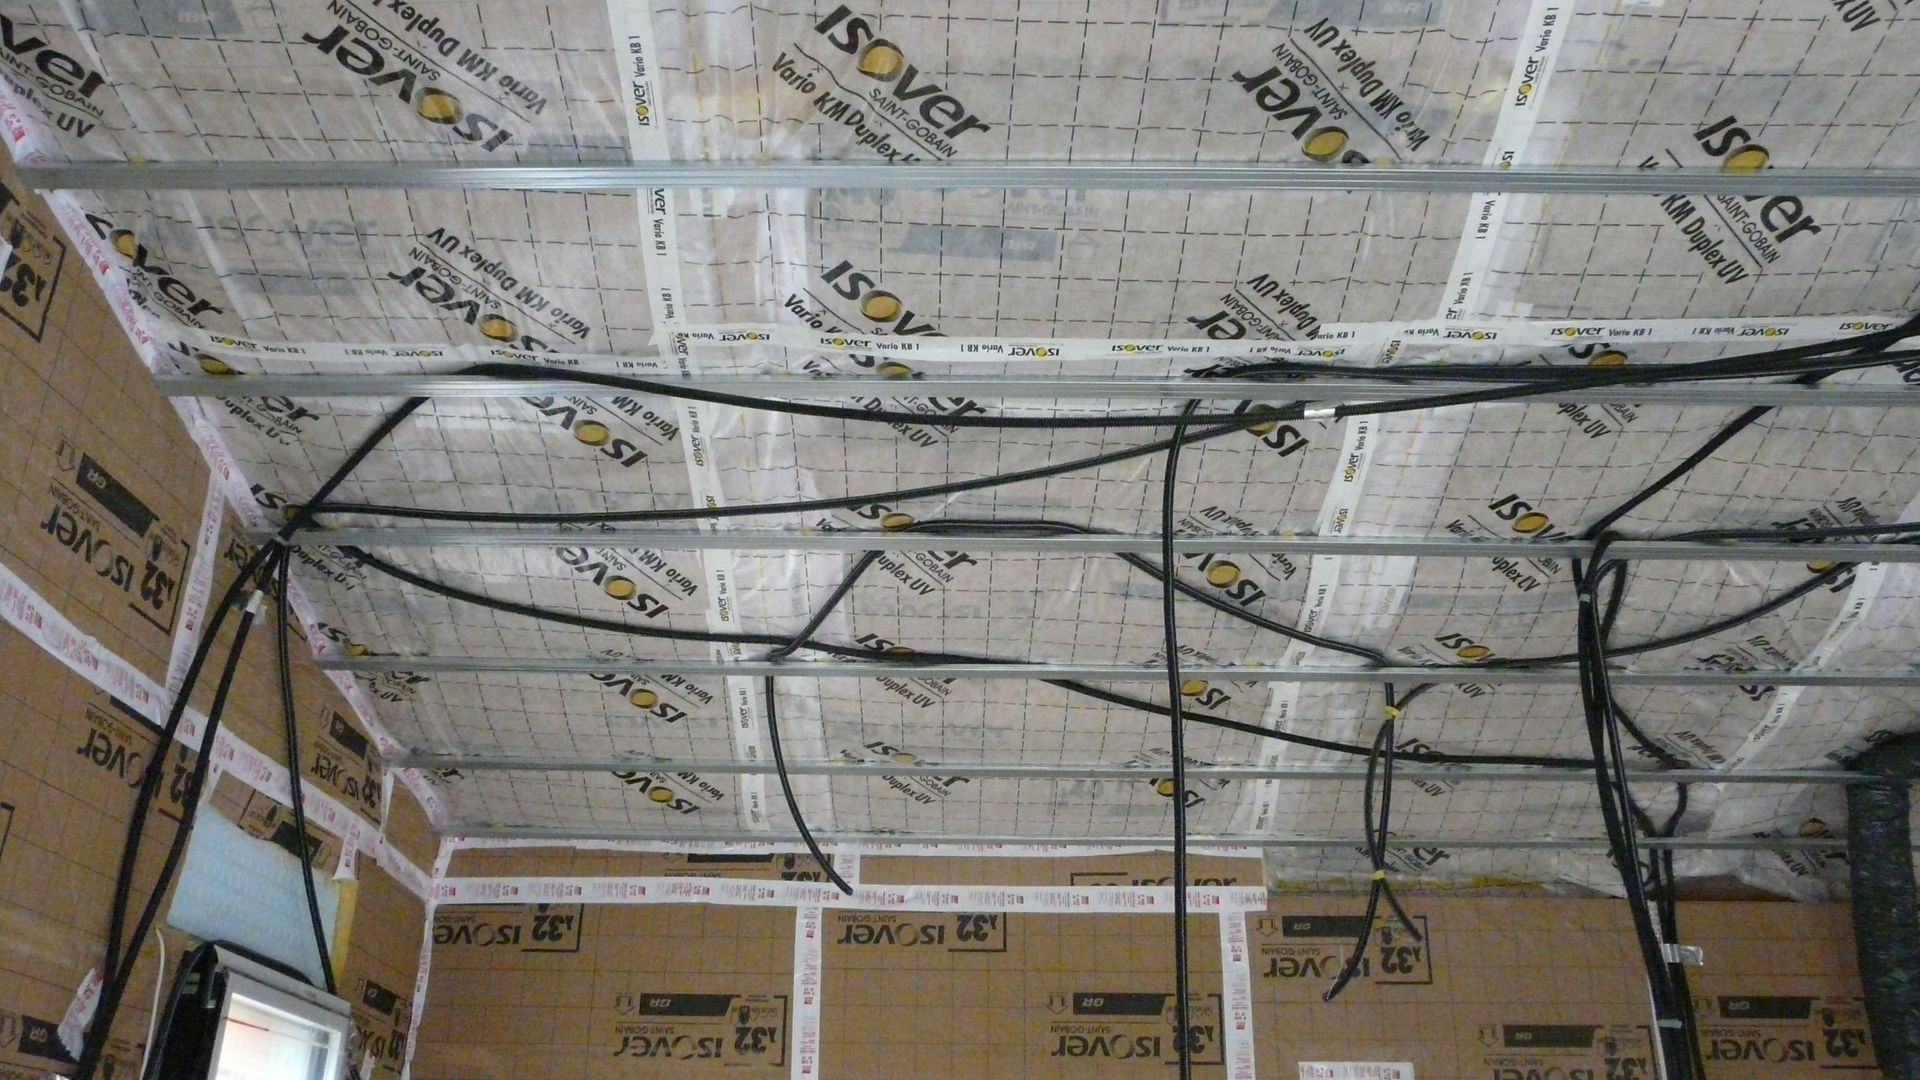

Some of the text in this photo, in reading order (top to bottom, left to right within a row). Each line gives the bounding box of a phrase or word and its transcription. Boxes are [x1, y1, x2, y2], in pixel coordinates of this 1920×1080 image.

[327, 0, 441, 82] SAINT-GOBAIN
[1304, 17, 1338, 50] UV
[1535, 29, 1551, 53] Vario
[389, 0, 548, 115] Vario KM Duplex
[630, 41, 641, 54] KB
[634, 54, 645, 79] Vario
[813, 4, 991, 139] isover
[1331, 41, 1385, 98] Duplex
[302, 25, 513, 152] isover
[1272, 43, 1347, 121] SAINT-GOBAIN
[772, 52, 902, 162] Vario KM Duplex
[56, 113, 95, 138] UV
[869, 87, 957, 159] SAINT-GOBAIN
[1480, 200, 1496, 221] Vario
[1681, 217, 1727, 271] Duplex
[1716, 259, 1750, 285] UV
[408, 247, 501, 310] SAINT-GOBAIN
[426, 227, 592, 339] Vario KM Duplex UV
[1247, 273, 1279, 298] UV
[784, 294, 824, 330] Vario
[820, 336, 872, 347] isover
[876, 342, 899, 350] Vario
[1608, 329, 1631, 337] Vario
[642, 410, 680, 441] Vario
[909, 428, 938, 448] UV
[1584, 420, 1611, 439] UV
[666, 569, 698, 597] Vario
[910, 578, 935, 595] UV
[685, 683, 714, 704] Vario
[913, 694, 935, 709] UV
[914, 793, 936, 805] UV
[838, 923, 945, 947] isover
[612, 1035, 723, 1060] isover
[1051, 1035, 1160, 1060] isover
[1706, 1038, 1816, 1063] isover
